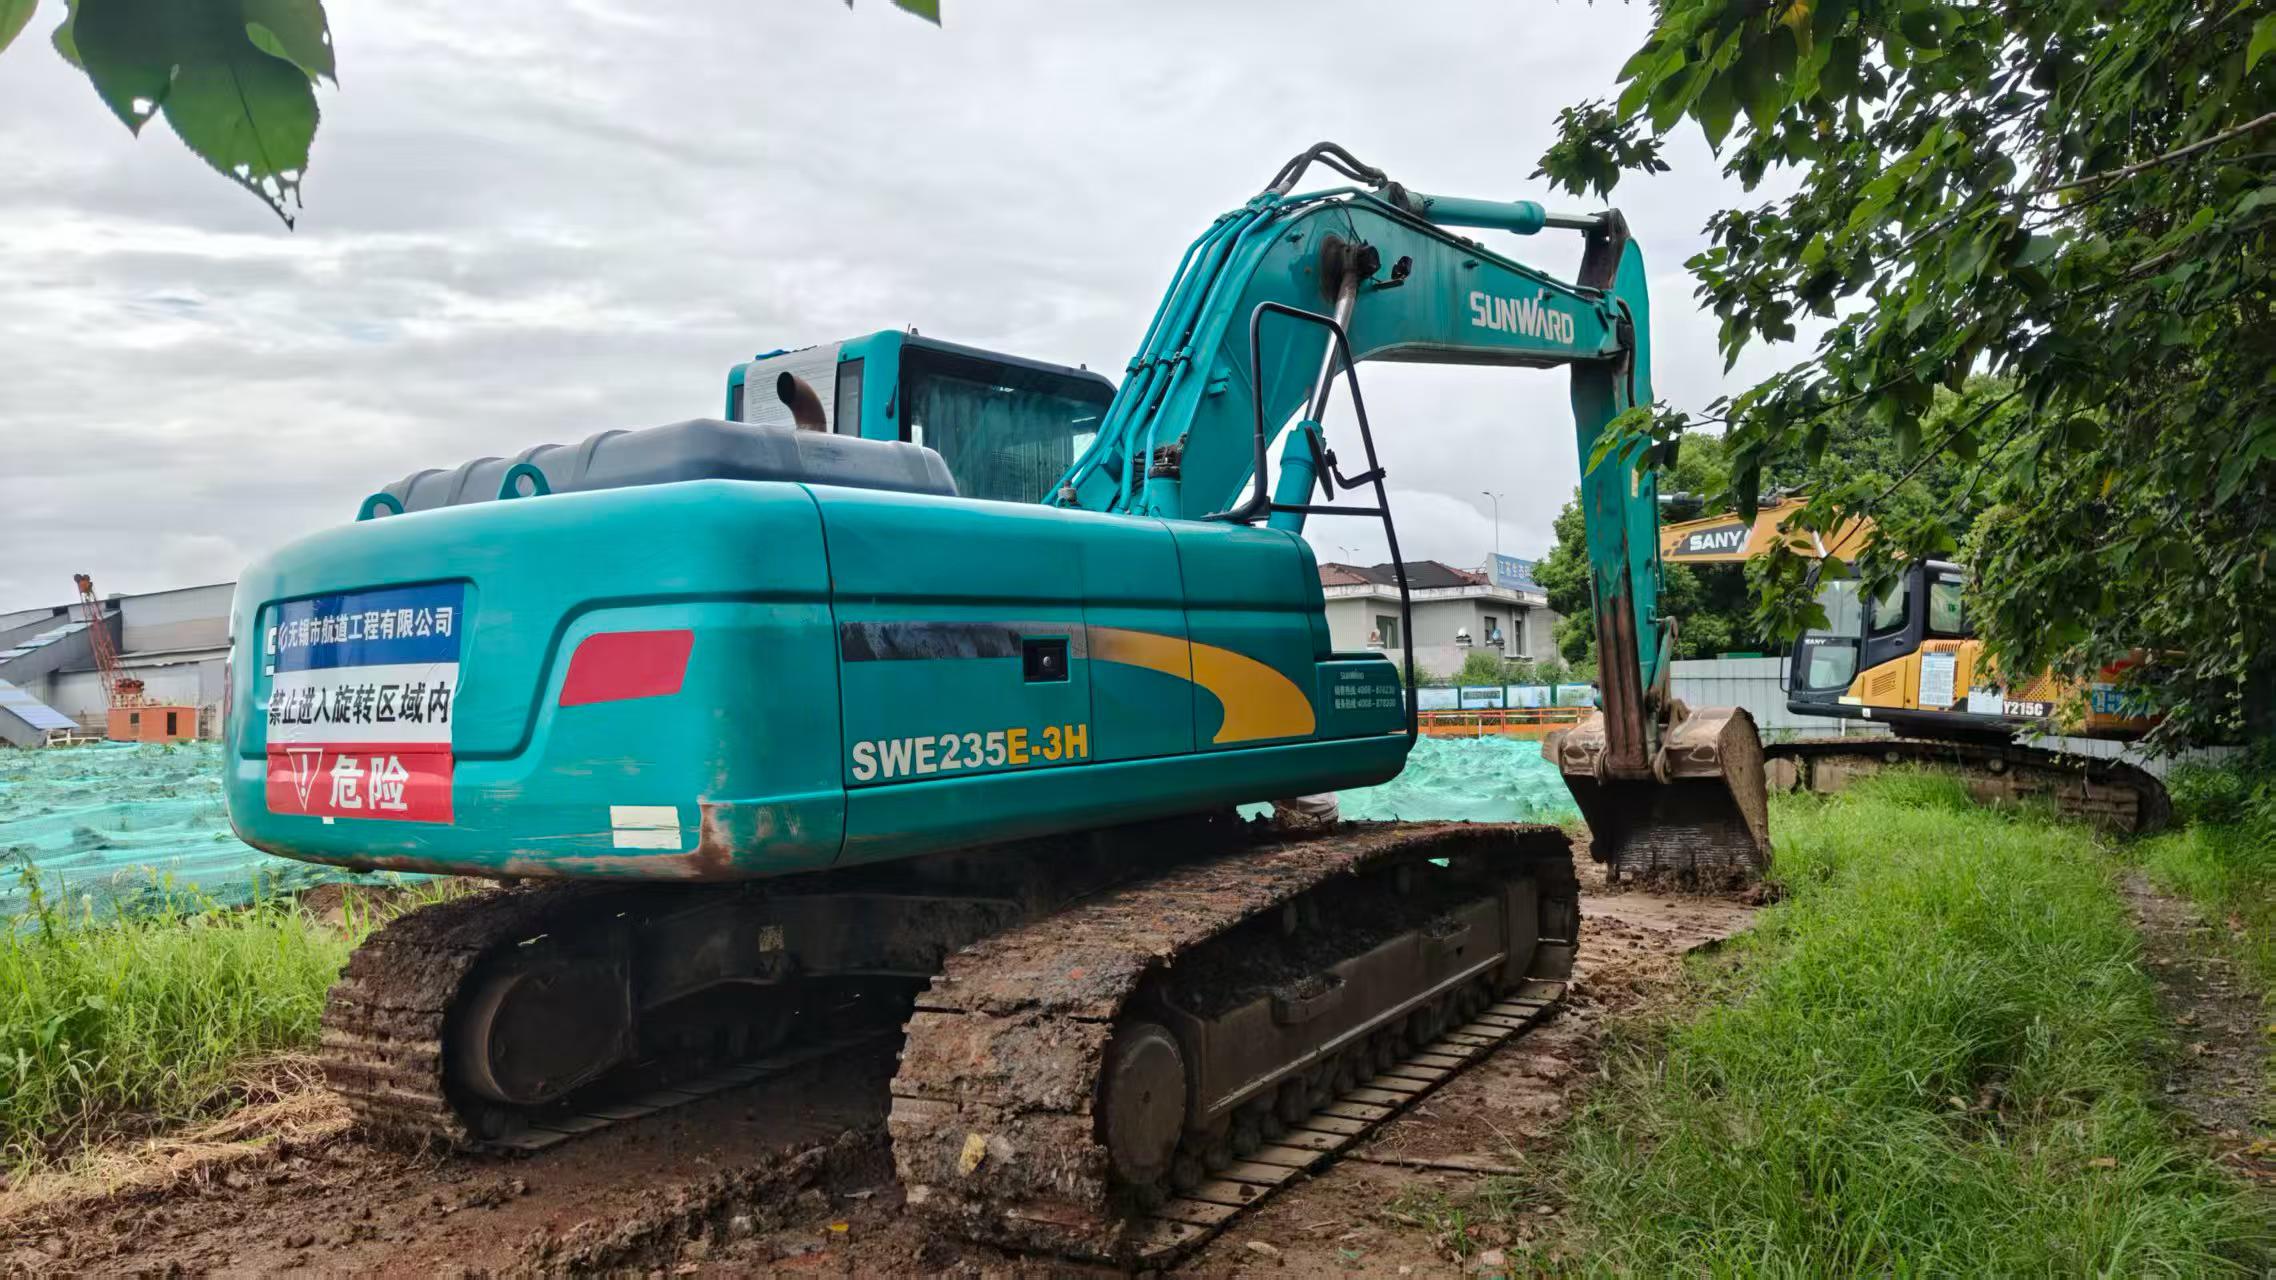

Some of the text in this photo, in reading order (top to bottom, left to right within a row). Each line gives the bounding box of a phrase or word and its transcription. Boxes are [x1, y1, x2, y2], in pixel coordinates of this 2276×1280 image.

[1470, 288, 1574, 345] SUNWARD
[1690, 530, 1743, 551] SANY
[288, 606, 453, 648] 无锡市航道工程有限公司
[269, 681, 452, 725] 禁止进入旋转区域内
[852, 723, 1089, 781] SWE235E-3H
[329, 755, 409, 811] 危险
